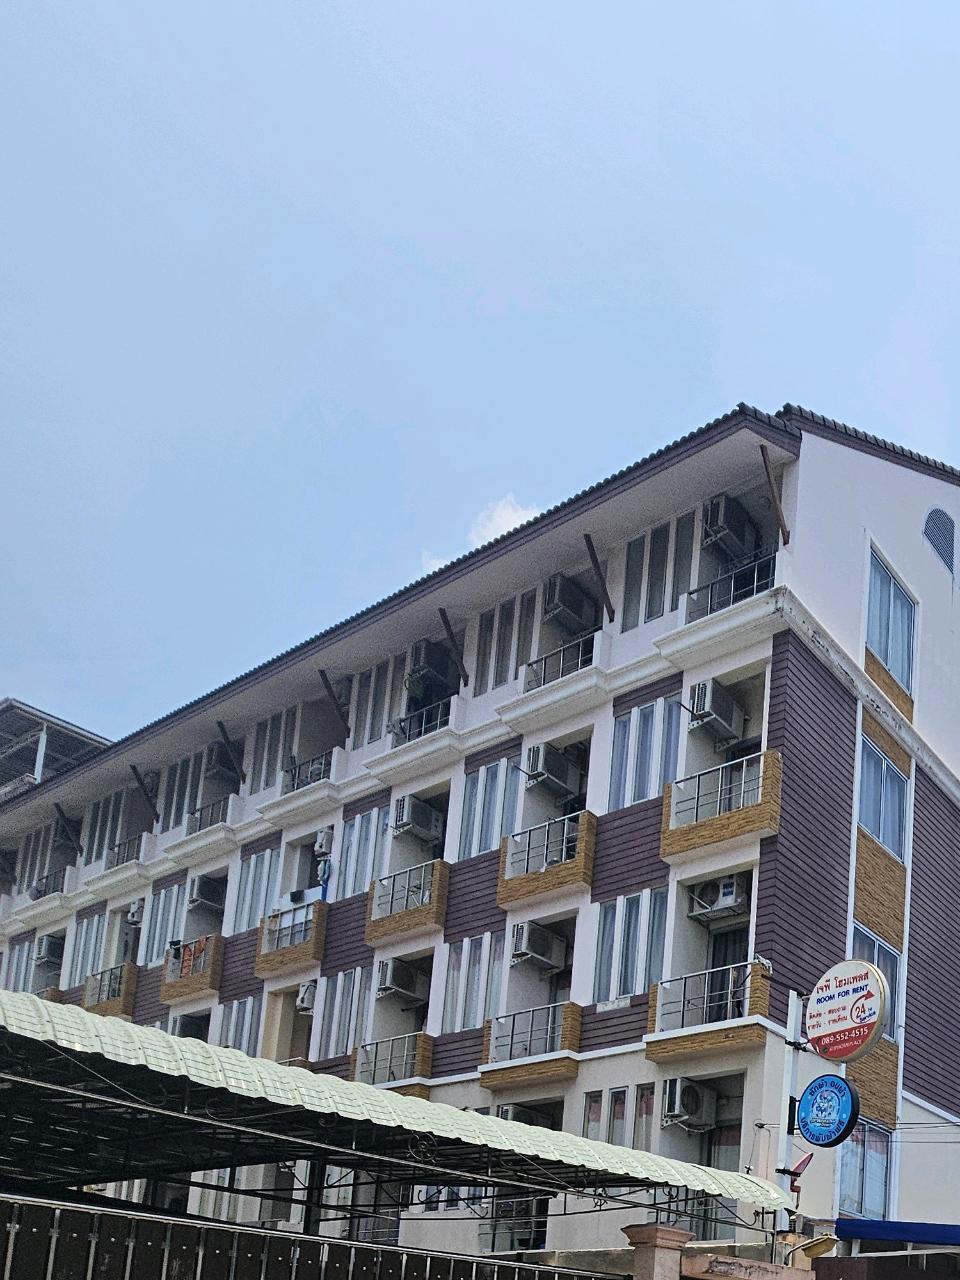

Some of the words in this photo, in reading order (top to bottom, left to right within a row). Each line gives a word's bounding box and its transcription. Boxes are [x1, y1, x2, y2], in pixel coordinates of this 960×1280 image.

[816, 994, 835, 1005] ROOM
[837, 989, 850, 999] FOR
[852, 984, 869, 996] RENT
[855, 1002, 866, 1020] 24
[821, 1026, 869, 1045] 089-552-4515
